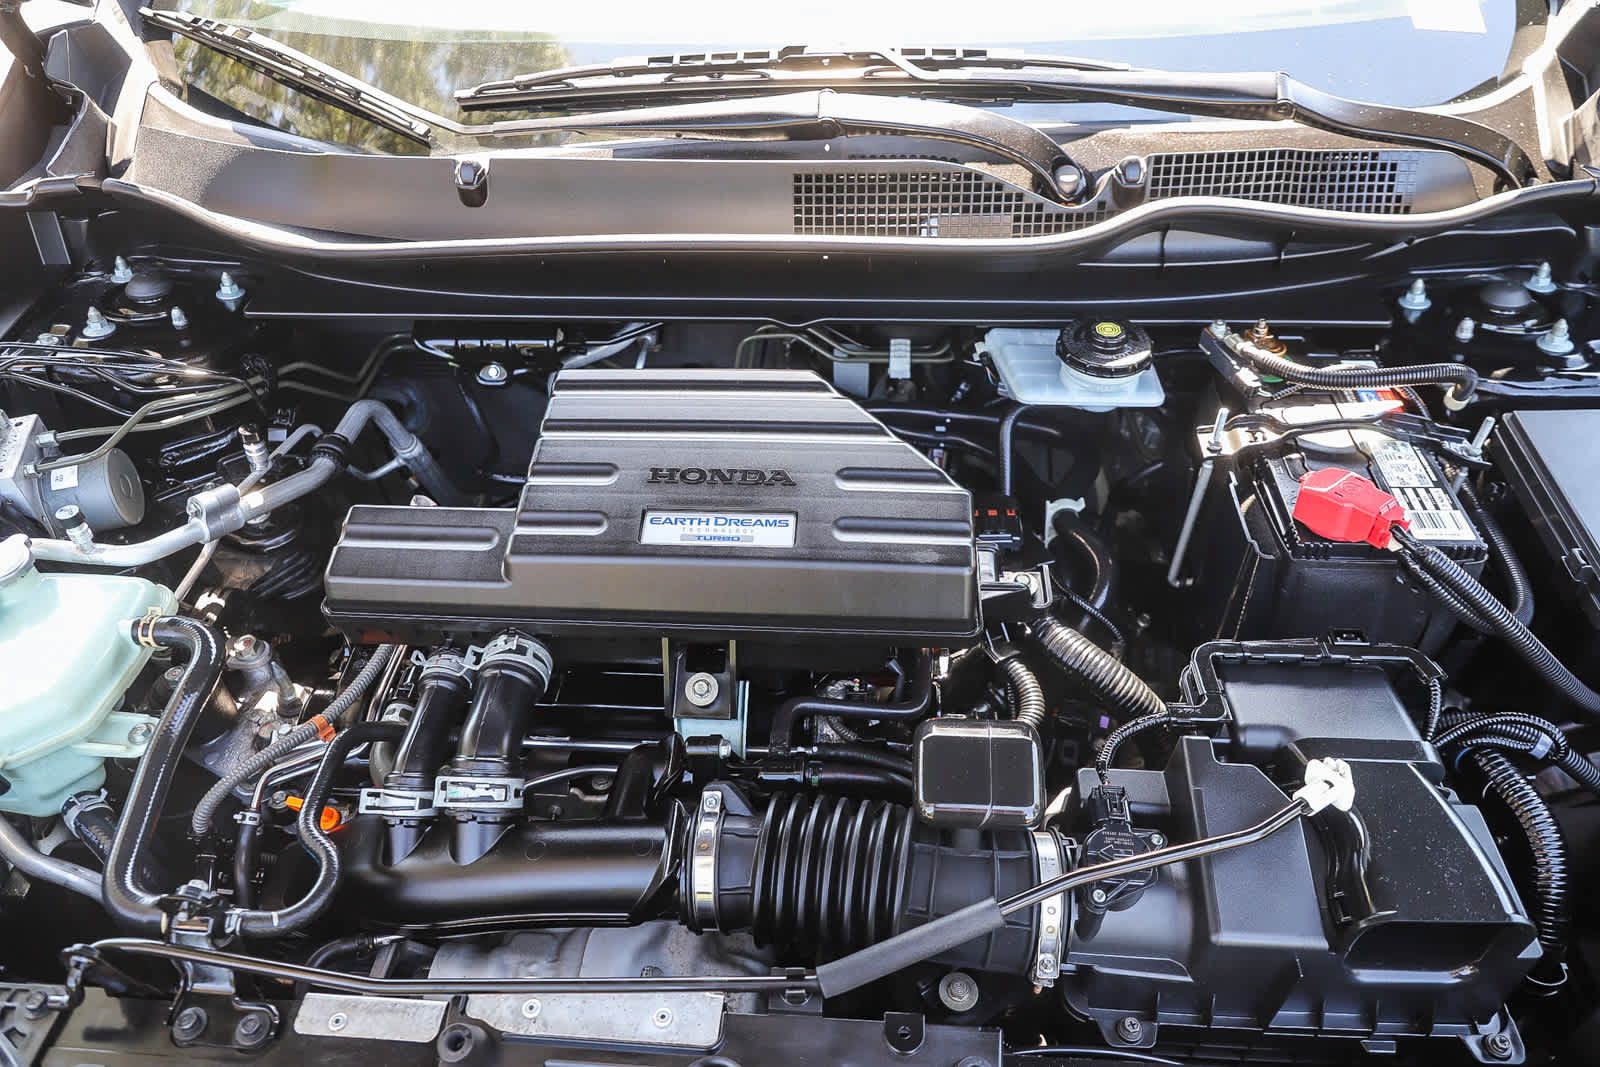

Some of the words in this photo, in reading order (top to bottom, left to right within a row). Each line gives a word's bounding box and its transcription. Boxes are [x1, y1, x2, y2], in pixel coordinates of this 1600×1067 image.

[647, 467, 797, 486] HONDA
[650, 516, 710, 526] EARTH
[714, 516, 790, 528] DREAMS
